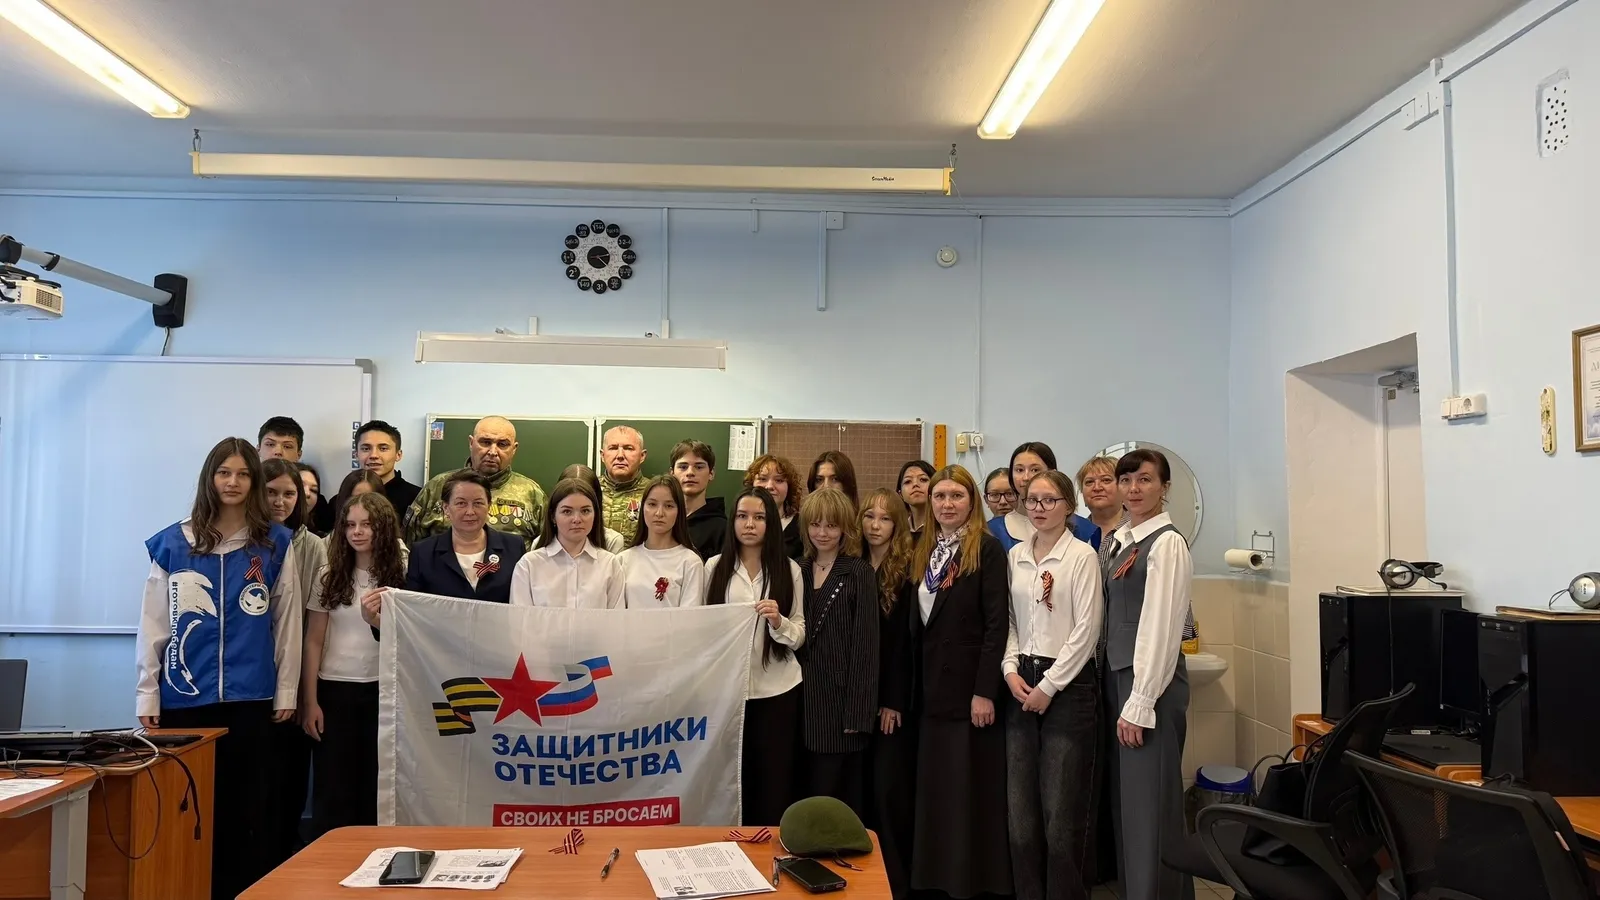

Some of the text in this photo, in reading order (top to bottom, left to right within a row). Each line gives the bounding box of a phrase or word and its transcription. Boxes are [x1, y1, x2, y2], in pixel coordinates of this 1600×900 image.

[491, 716, 708, 761] ЗАЩИТНИКИ
[494, 749, 682, 786] ОТЕЧЕСТВА
[500, 803, 673, 826] СВОИХ НЕ БРОСАЕМ
